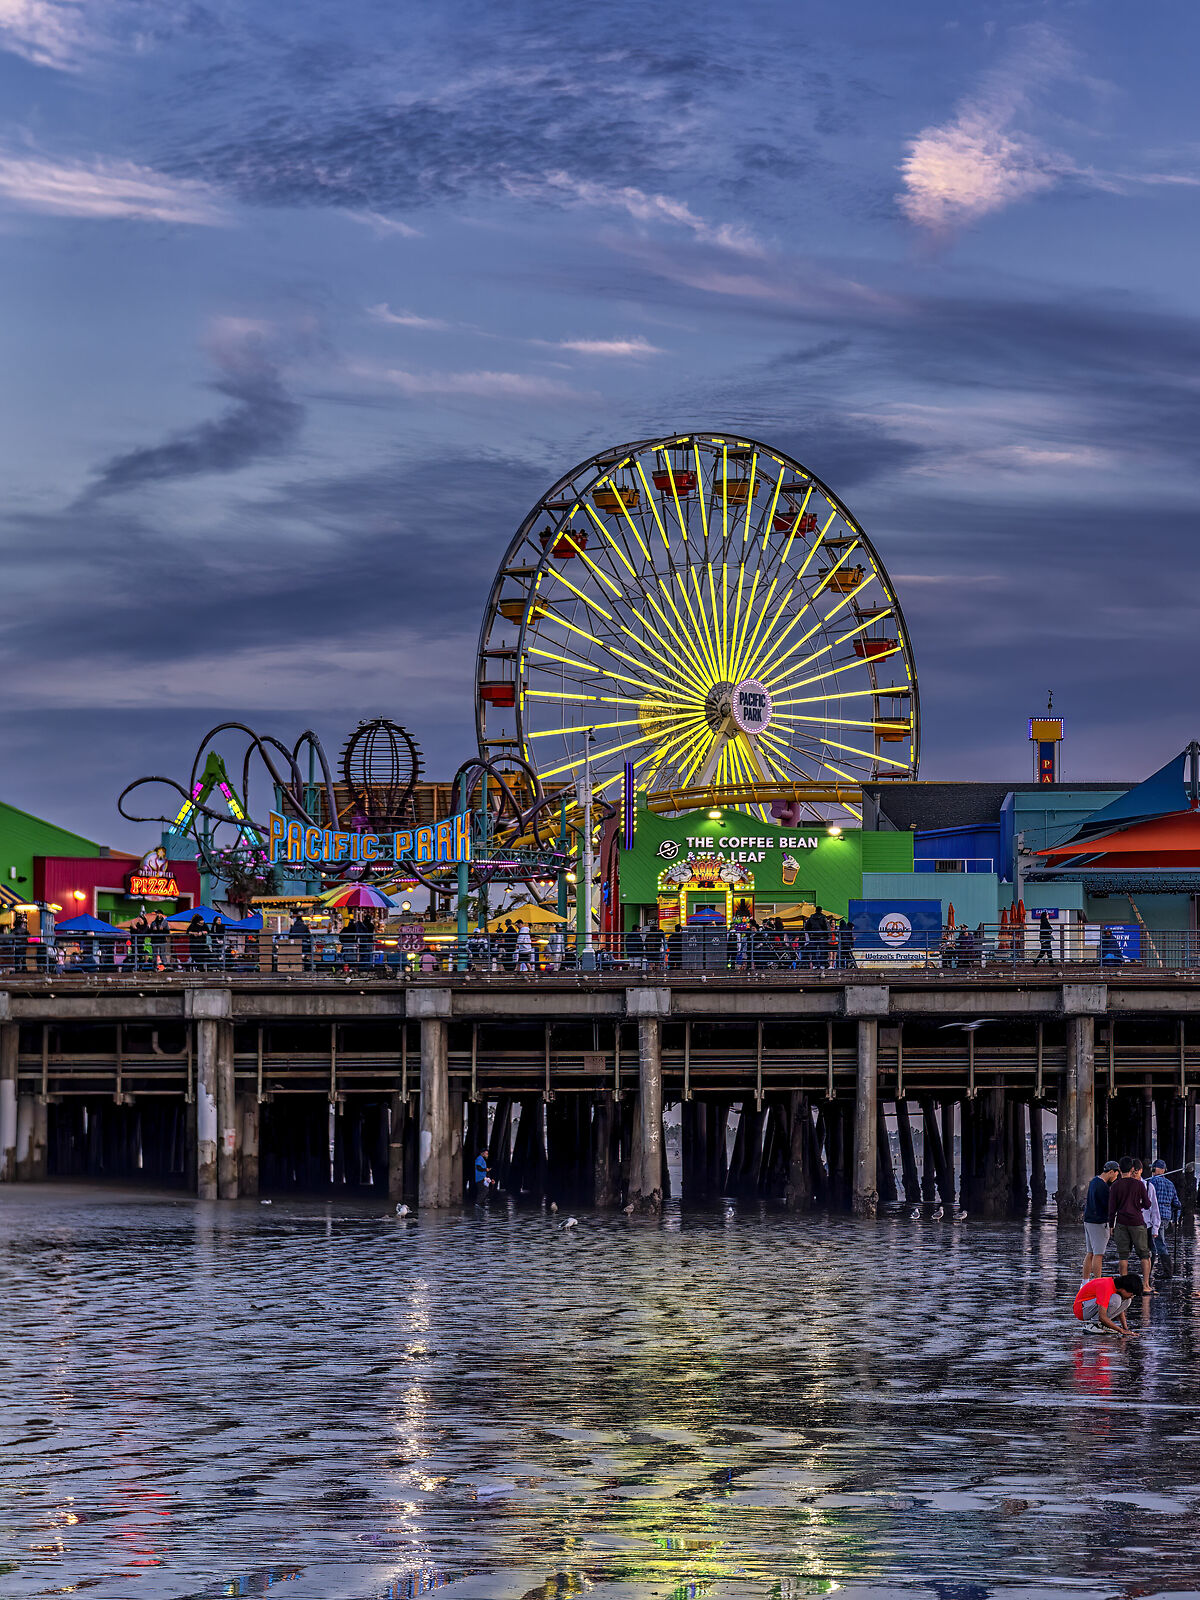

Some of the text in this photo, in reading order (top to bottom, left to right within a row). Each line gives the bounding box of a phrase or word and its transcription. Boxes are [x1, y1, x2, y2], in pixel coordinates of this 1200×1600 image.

[740, 692, 766, 707] PACIFIC
[743, 707, 762, 722] PARK
[269, 808, 473, 864] PACIFIC PARK
[686, 837, 818, 848] THE COFFEE BEAN
[731, 852, 766, 863] LEAF
[130, 875, 180, 896] PIZZA
[865, 952, 926, 960] Wetzel's Pretzels
